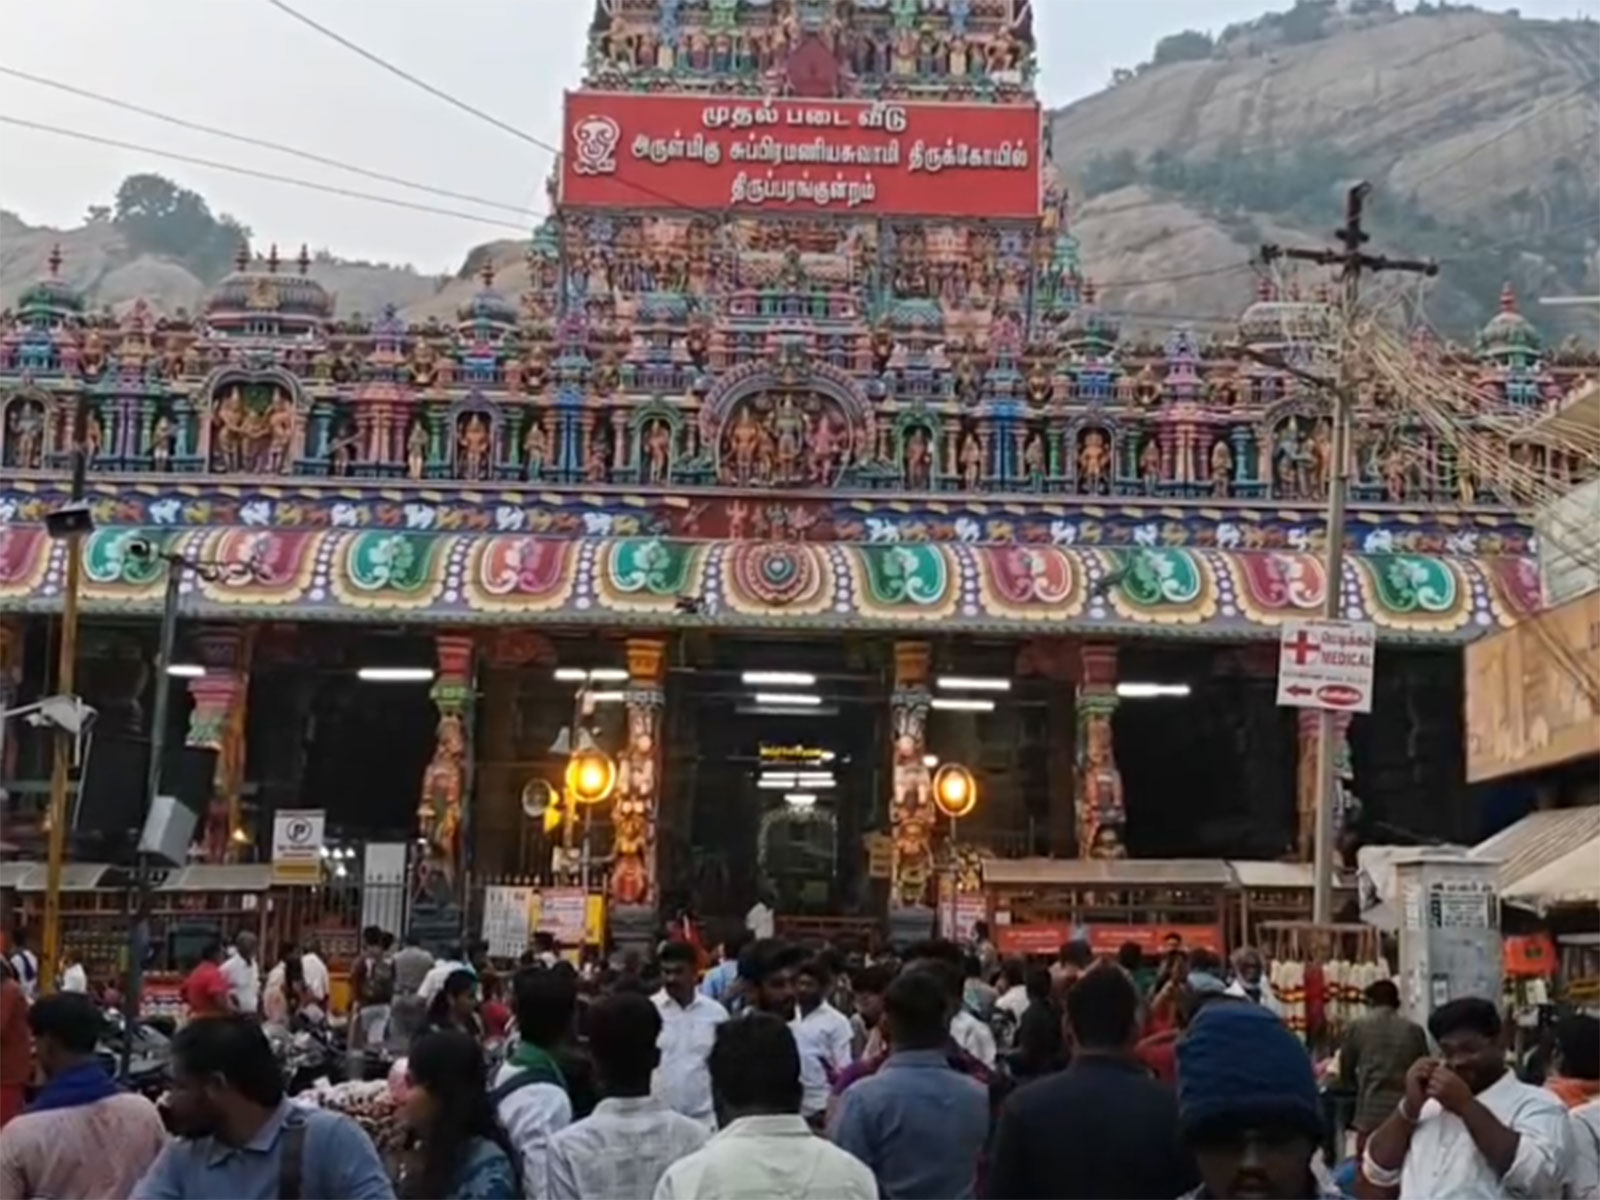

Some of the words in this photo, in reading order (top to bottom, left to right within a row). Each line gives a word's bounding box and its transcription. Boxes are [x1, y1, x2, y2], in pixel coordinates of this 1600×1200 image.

[702, 98, 779, 128] முதல்
[786, 108, 850, 126] படை
[858, 100, 906, 131] வீடு
[632, 130, 720, 163] அருள்மிகு
[730, 132, 899, 166] சுப்பிரமணியசுவாமி
[908, 138, 1028, 171] திருக்கோயில்
[731, 170, 875, 207] திருப்பரங்குன்றம்
[1321, 651, 1371, 668] MEDICAL
